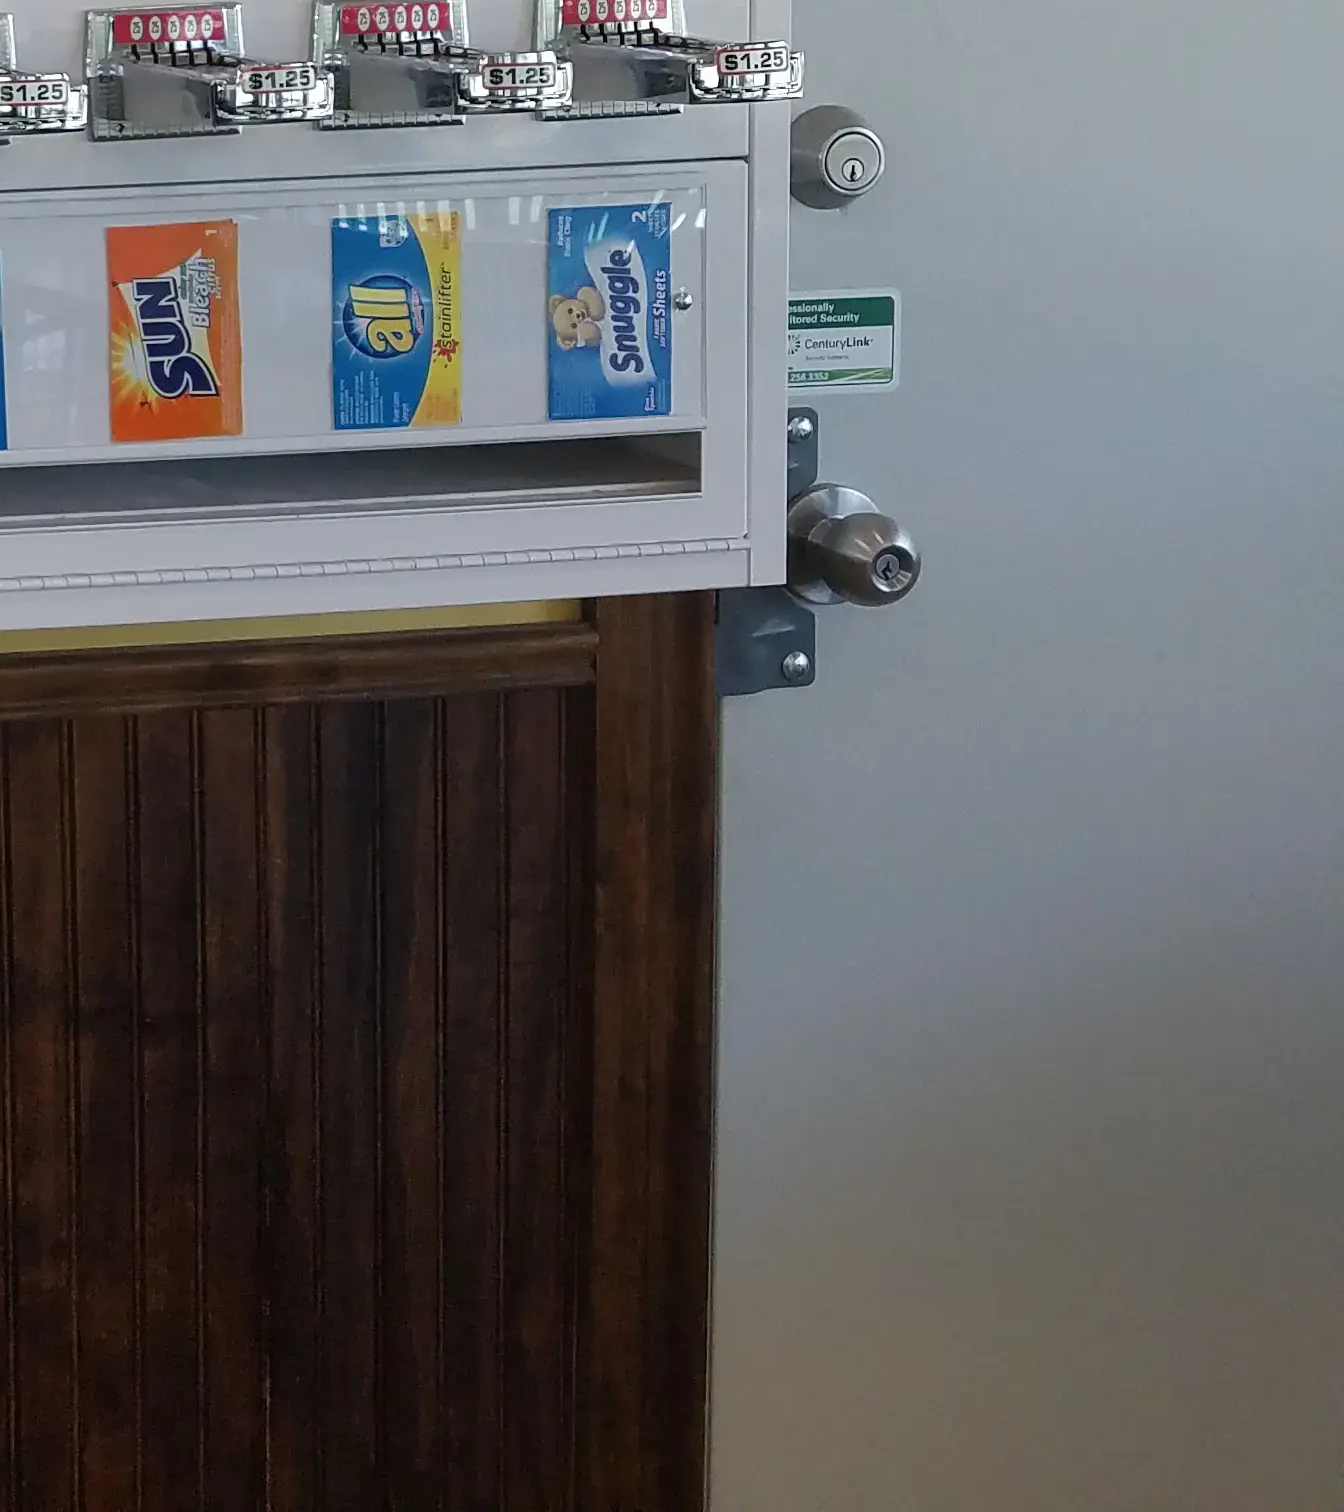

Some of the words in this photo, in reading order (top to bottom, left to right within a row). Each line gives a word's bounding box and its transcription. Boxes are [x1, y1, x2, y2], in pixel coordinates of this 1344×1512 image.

[724, 51, 784, 71] $1.25
[248, 70, 312, 90] $1.25
[489, 67, 551, 86] $1.25
[0, 83, 63, 102] $1.25
[632, 211, 647, 223] 2
[188, 257, 211, 327] Bleach
[653, 270, 667, 317] Sheets
[439, 267, 453, 348] stainlifter
[599, 249, 645, 373] Snuggle
[788, 303, 835, 314] essionally
[348, 285, 416, 354] all
[789, 316, 818, 325] itored
[820, 312, 861, 324] Security
[133, 276, 220, 399] SUN
[804, 337, 871, 350] CenturyLink
